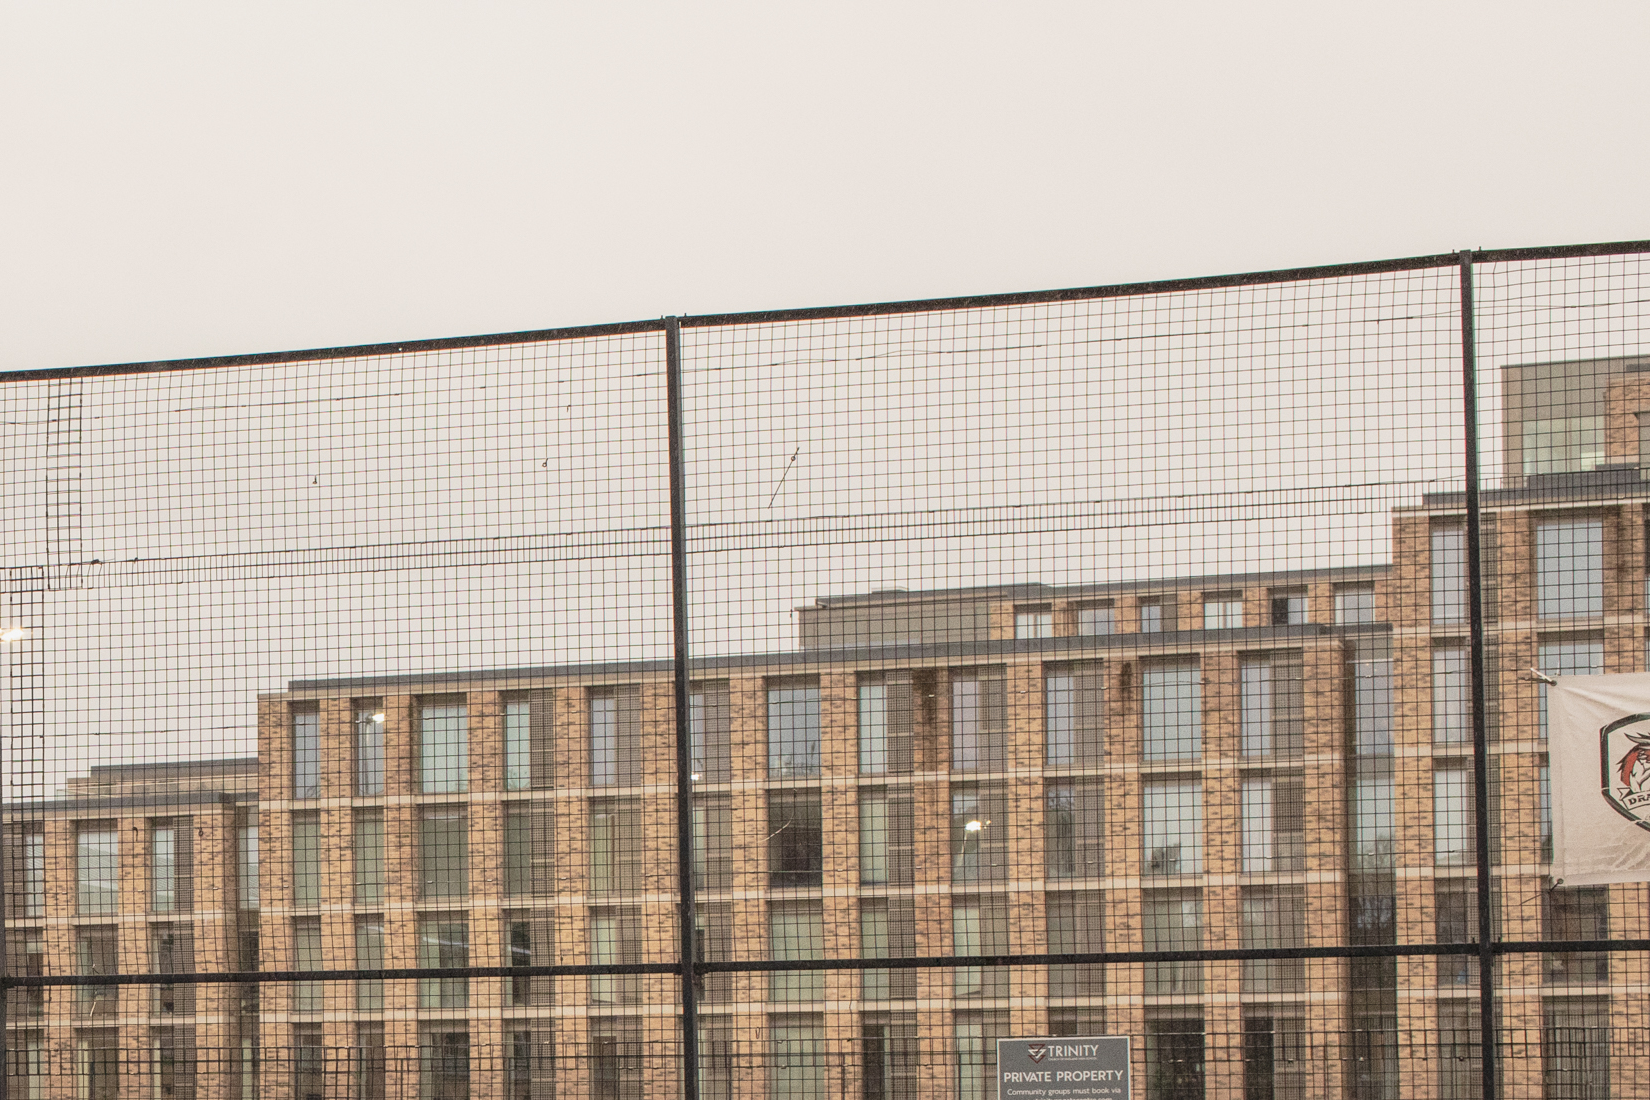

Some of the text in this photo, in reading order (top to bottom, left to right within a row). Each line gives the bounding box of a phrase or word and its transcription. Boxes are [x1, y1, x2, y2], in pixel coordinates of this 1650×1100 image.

[1048, 1044, 1099, 1057] TRINITY
[1003, 1070, 1123, 1082] PRIVATE PROPERTY
